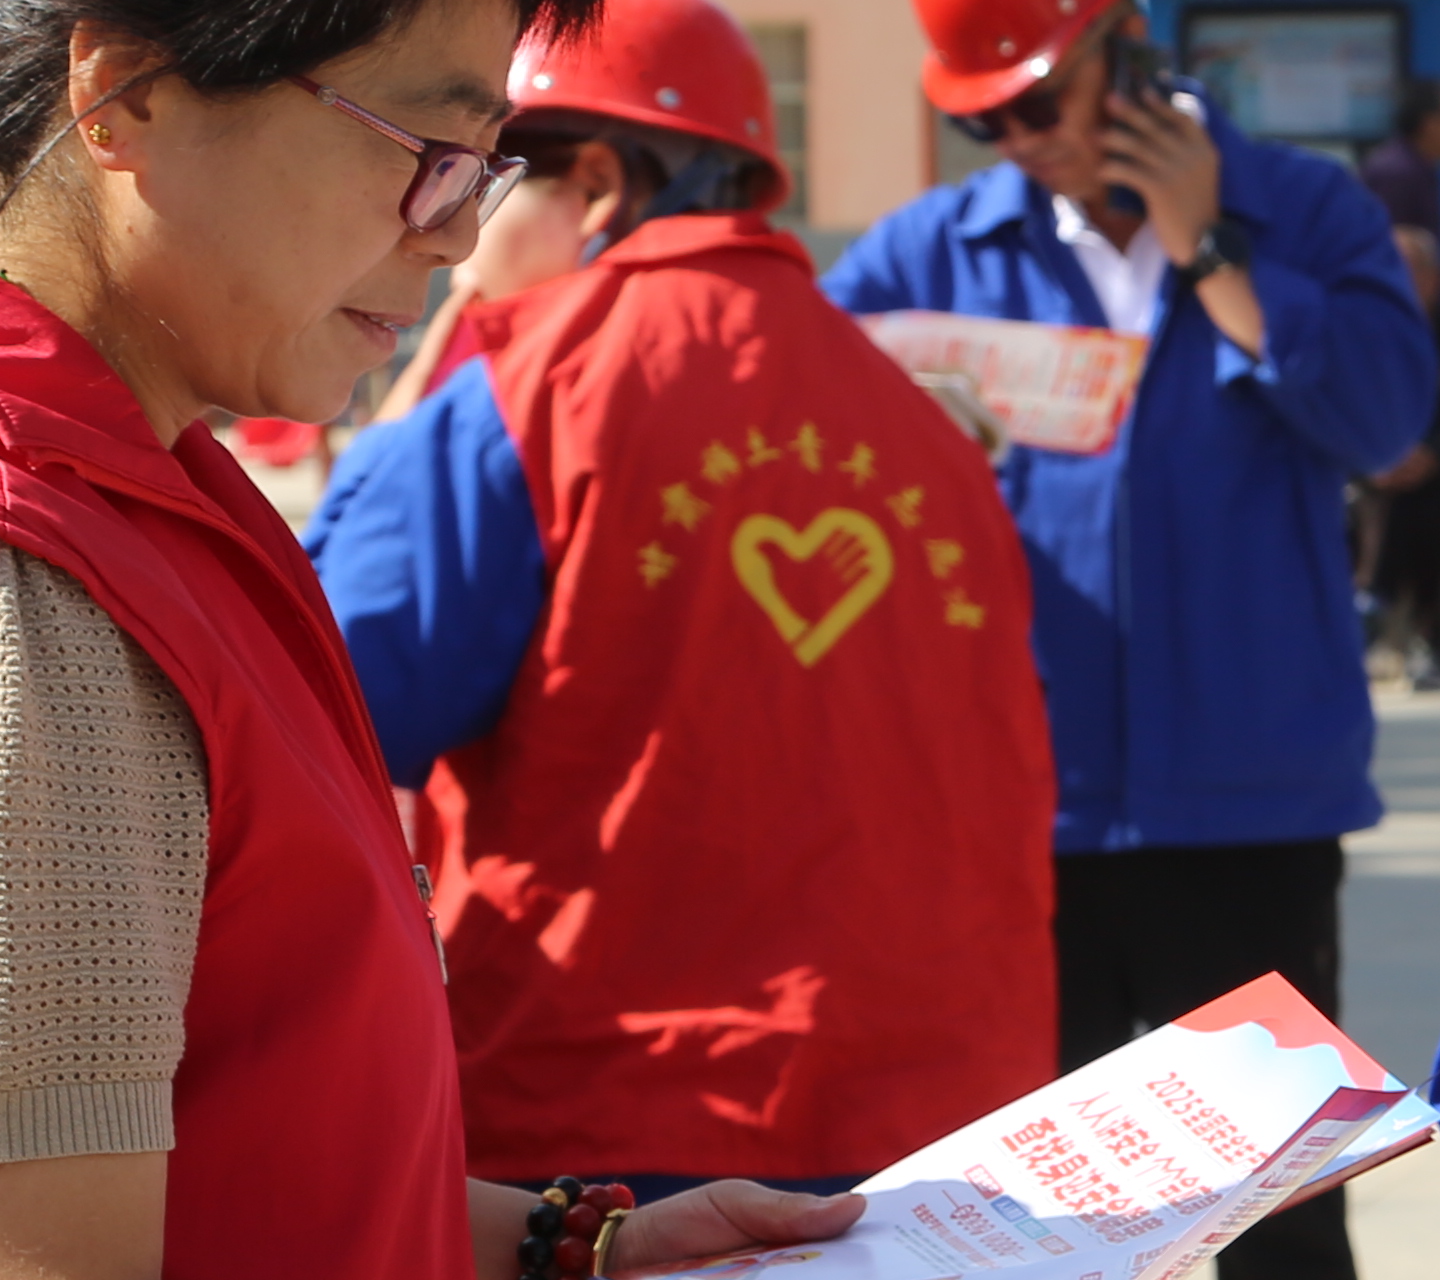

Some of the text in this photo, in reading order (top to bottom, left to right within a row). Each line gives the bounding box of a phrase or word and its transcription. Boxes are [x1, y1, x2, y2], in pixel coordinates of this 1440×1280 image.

[1067, 1091, 1162, 1167] 人人讲安全
